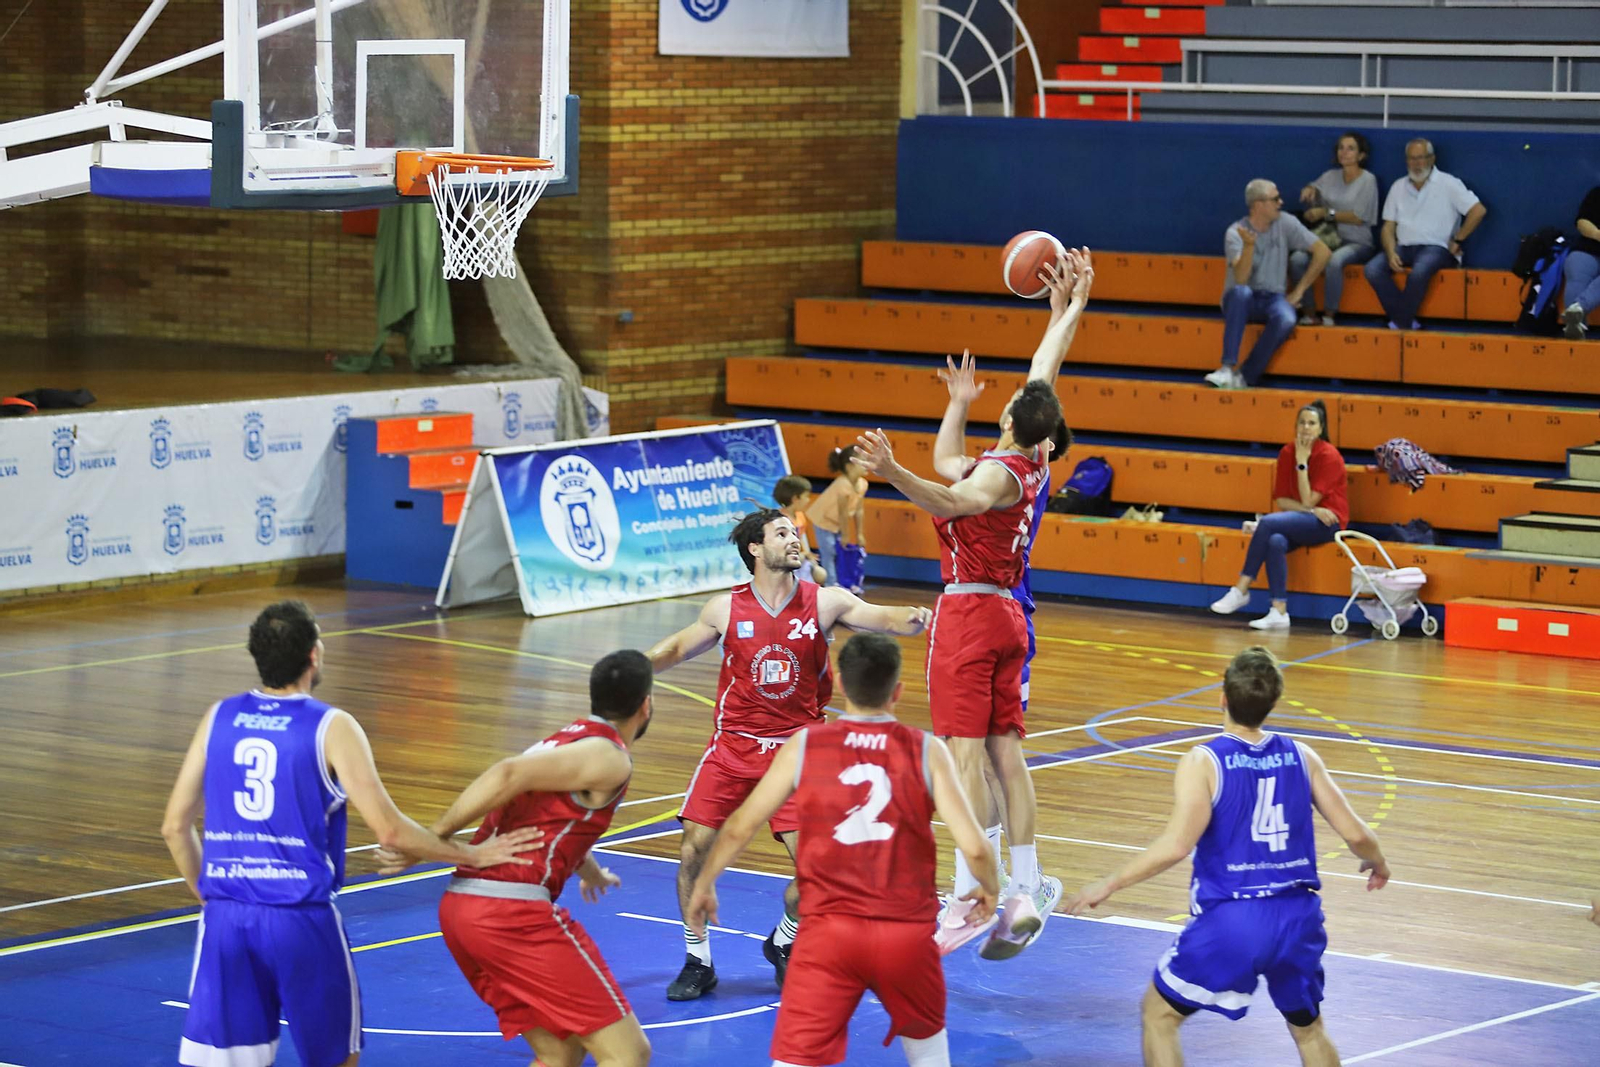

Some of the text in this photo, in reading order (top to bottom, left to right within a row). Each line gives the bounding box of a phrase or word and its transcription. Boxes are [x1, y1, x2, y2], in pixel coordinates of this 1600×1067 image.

[174, 448, 211, 461] HUELVA
[266, 441, 302, 453] HUELVA
[80, 457, 117, 470] HUELVA
[613, 456, 734, 494] Ayuntamiento
[657, 482, 740, 511] de Huelva
[685, 515, 698, 529] de
[188, 533, 224, 546] HUELVA
[92, 543, 131, 557] HUELVA
[787, 618, 819, 640] 24
[233, 712, 293, 731] PÉREZ
[844, 731, 888, 750] ANYI
[1225, 752, 1283, 770] CÁRDENAS
[233, 737, 278, 821] 3
[832, 761, 895, 846] 2
[1251, 776, 1290, 852] 4
[206, 862, 226, 879] La
